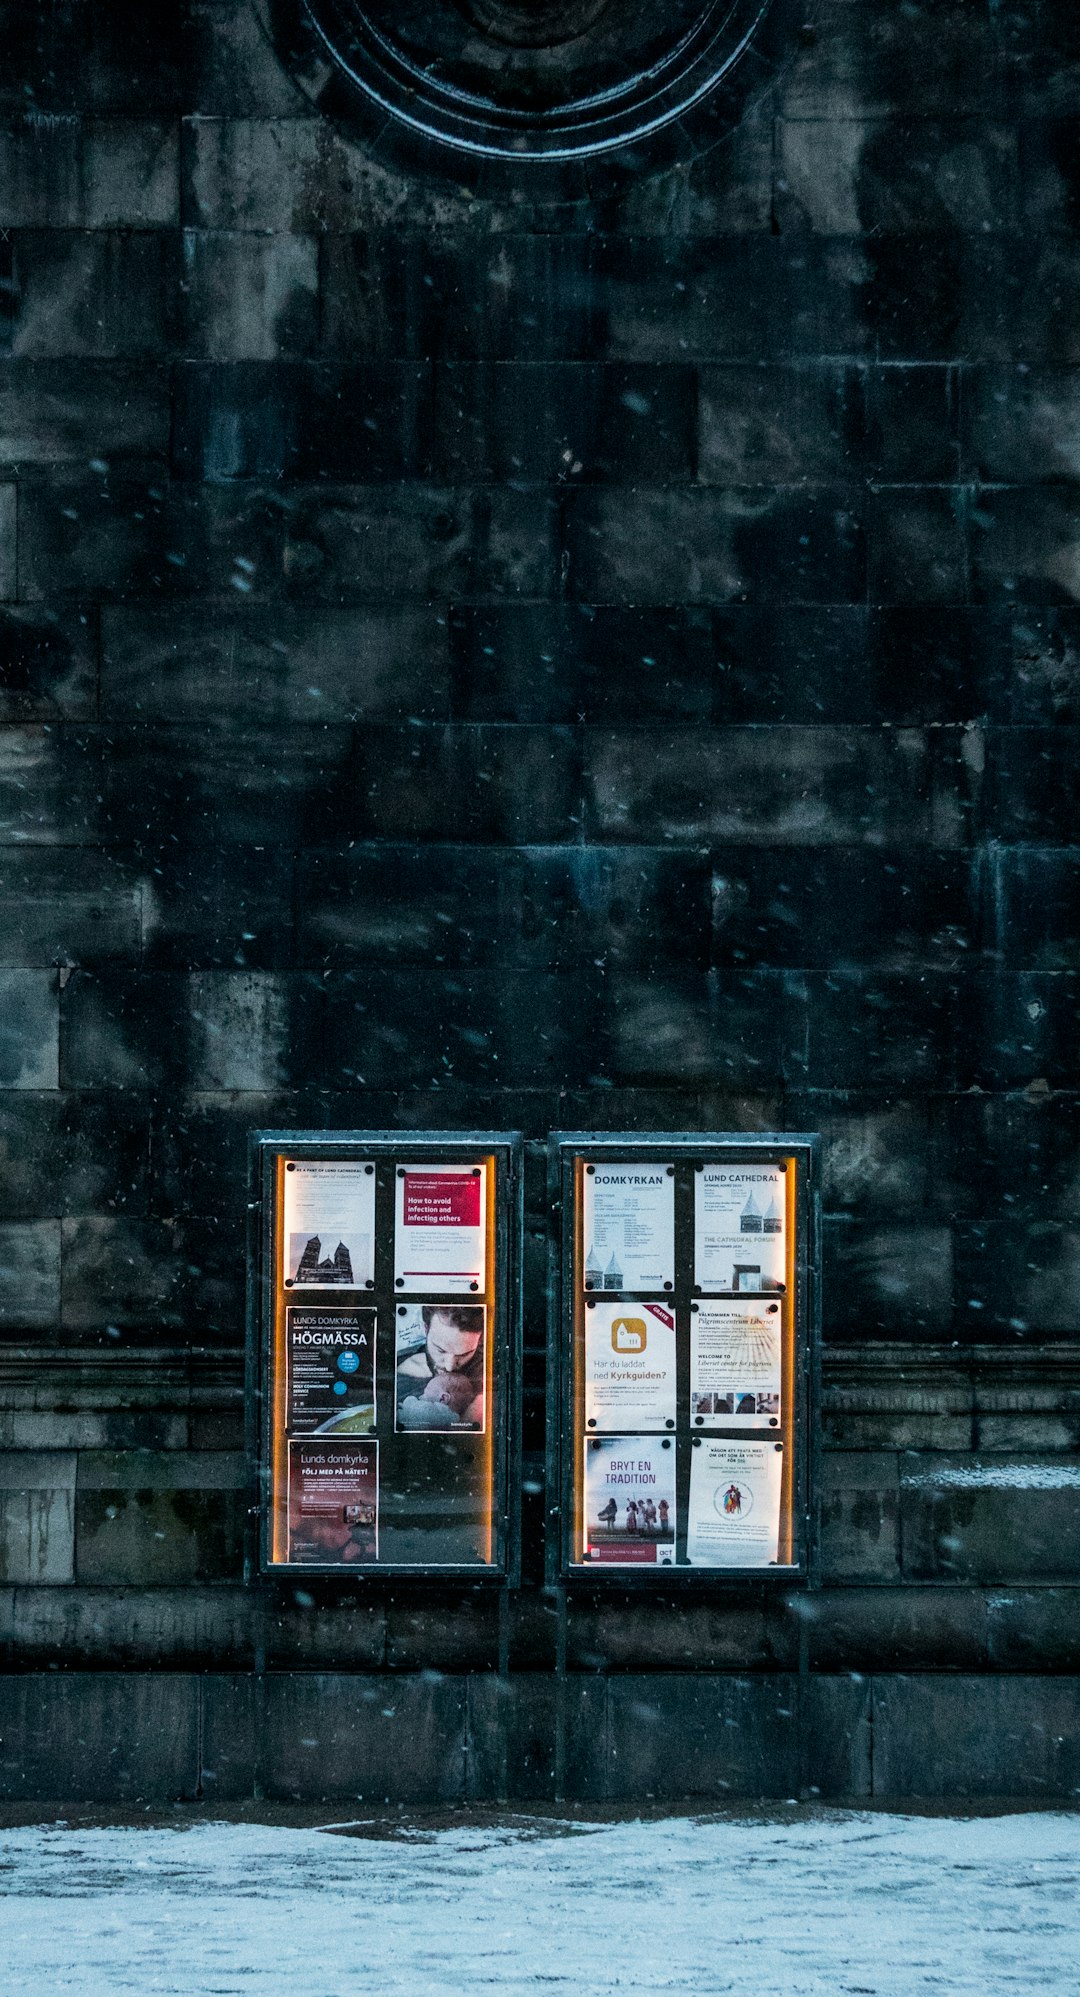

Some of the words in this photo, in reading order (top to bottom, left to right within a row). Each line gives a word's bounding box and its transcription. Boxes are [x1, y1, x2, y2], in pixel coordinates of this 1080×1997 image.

[594, 1176, 663, 1185] DOMKYRKAN
[408, 1197, 423, 1205] How
[408, 1215, 438, 1223] infecting
[652, 1306, 670, 1321] GRATIS
[293, 1317, 317, 1325] LUNDS
[318, 1317, 359, 1325] DOMKYRKA
[698, 1317, 749, 1325] Pilgrimscentrum
[292, 1331, 367, 1345] HÖGMÄSSA
[594, 1360, 608, 1368] Har
[609, 1360, 620, 1368] du
[621, 1360, 646, 1368] laddat
[594, 1371, 609, 1380] ned
[610, 1371, 667, 1381] Kyrkguiden?
[301, 1454, 325, 1463] Lunds
[327, 1454, 369, 1466] domkyrka
[610, 1461, 635, 1471] BRYT
[638, 1461, 651, 1471] EN
[335, 1467, 343, 1475] PÅ
[605, 1473, 656, 1484] TRADITION
